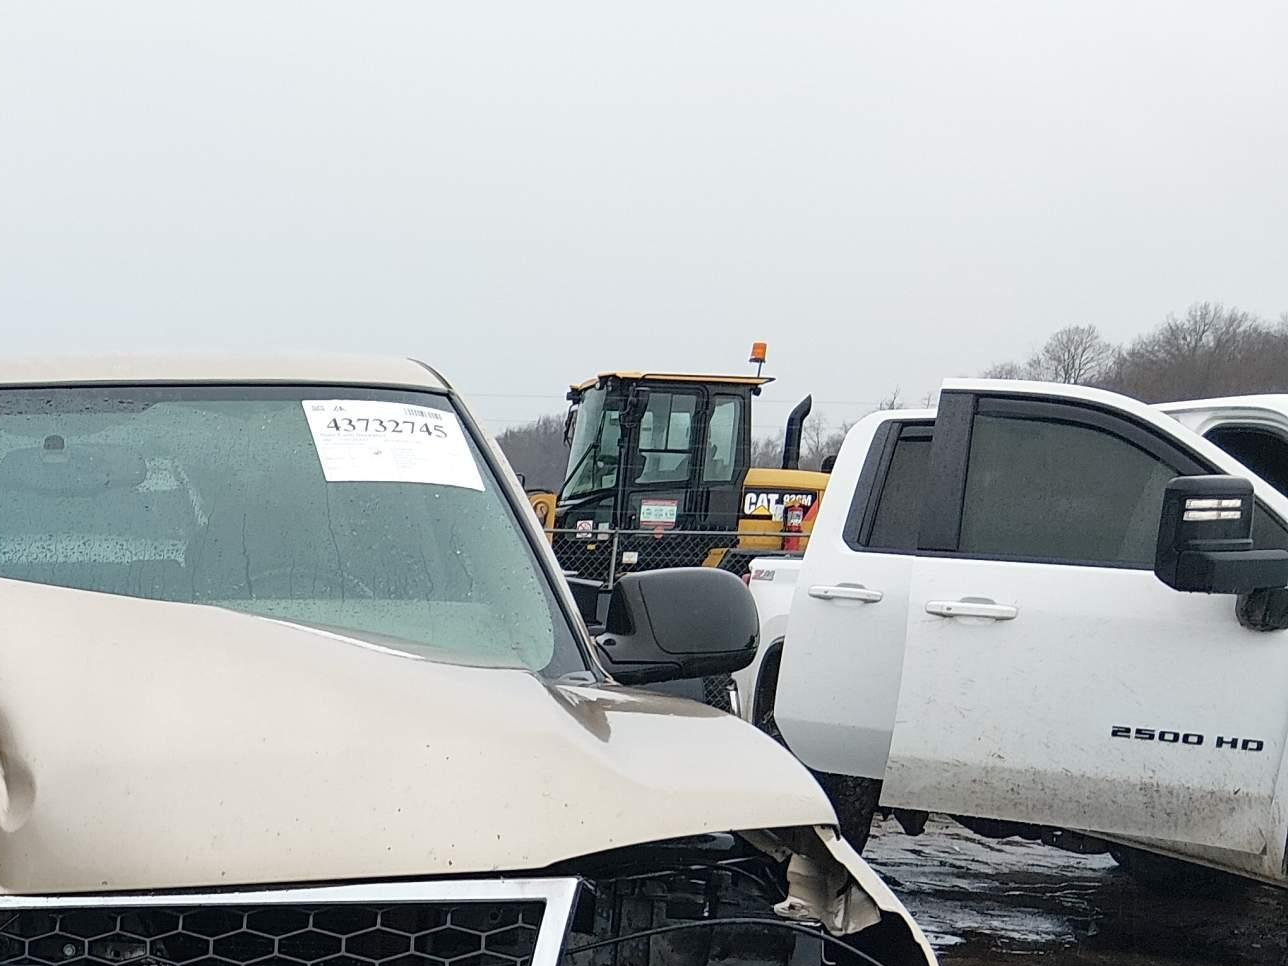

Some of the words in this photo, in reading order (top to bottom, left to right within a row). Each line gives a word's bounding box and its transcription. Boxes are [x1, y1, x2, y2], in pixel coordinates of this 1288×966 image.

[326, 417, 448, 439] 43732745
[743, 492, 780, 515] CAT
[1111, 725, 1204, 746] 2500
[1215, 736, 1264, 752] HD
